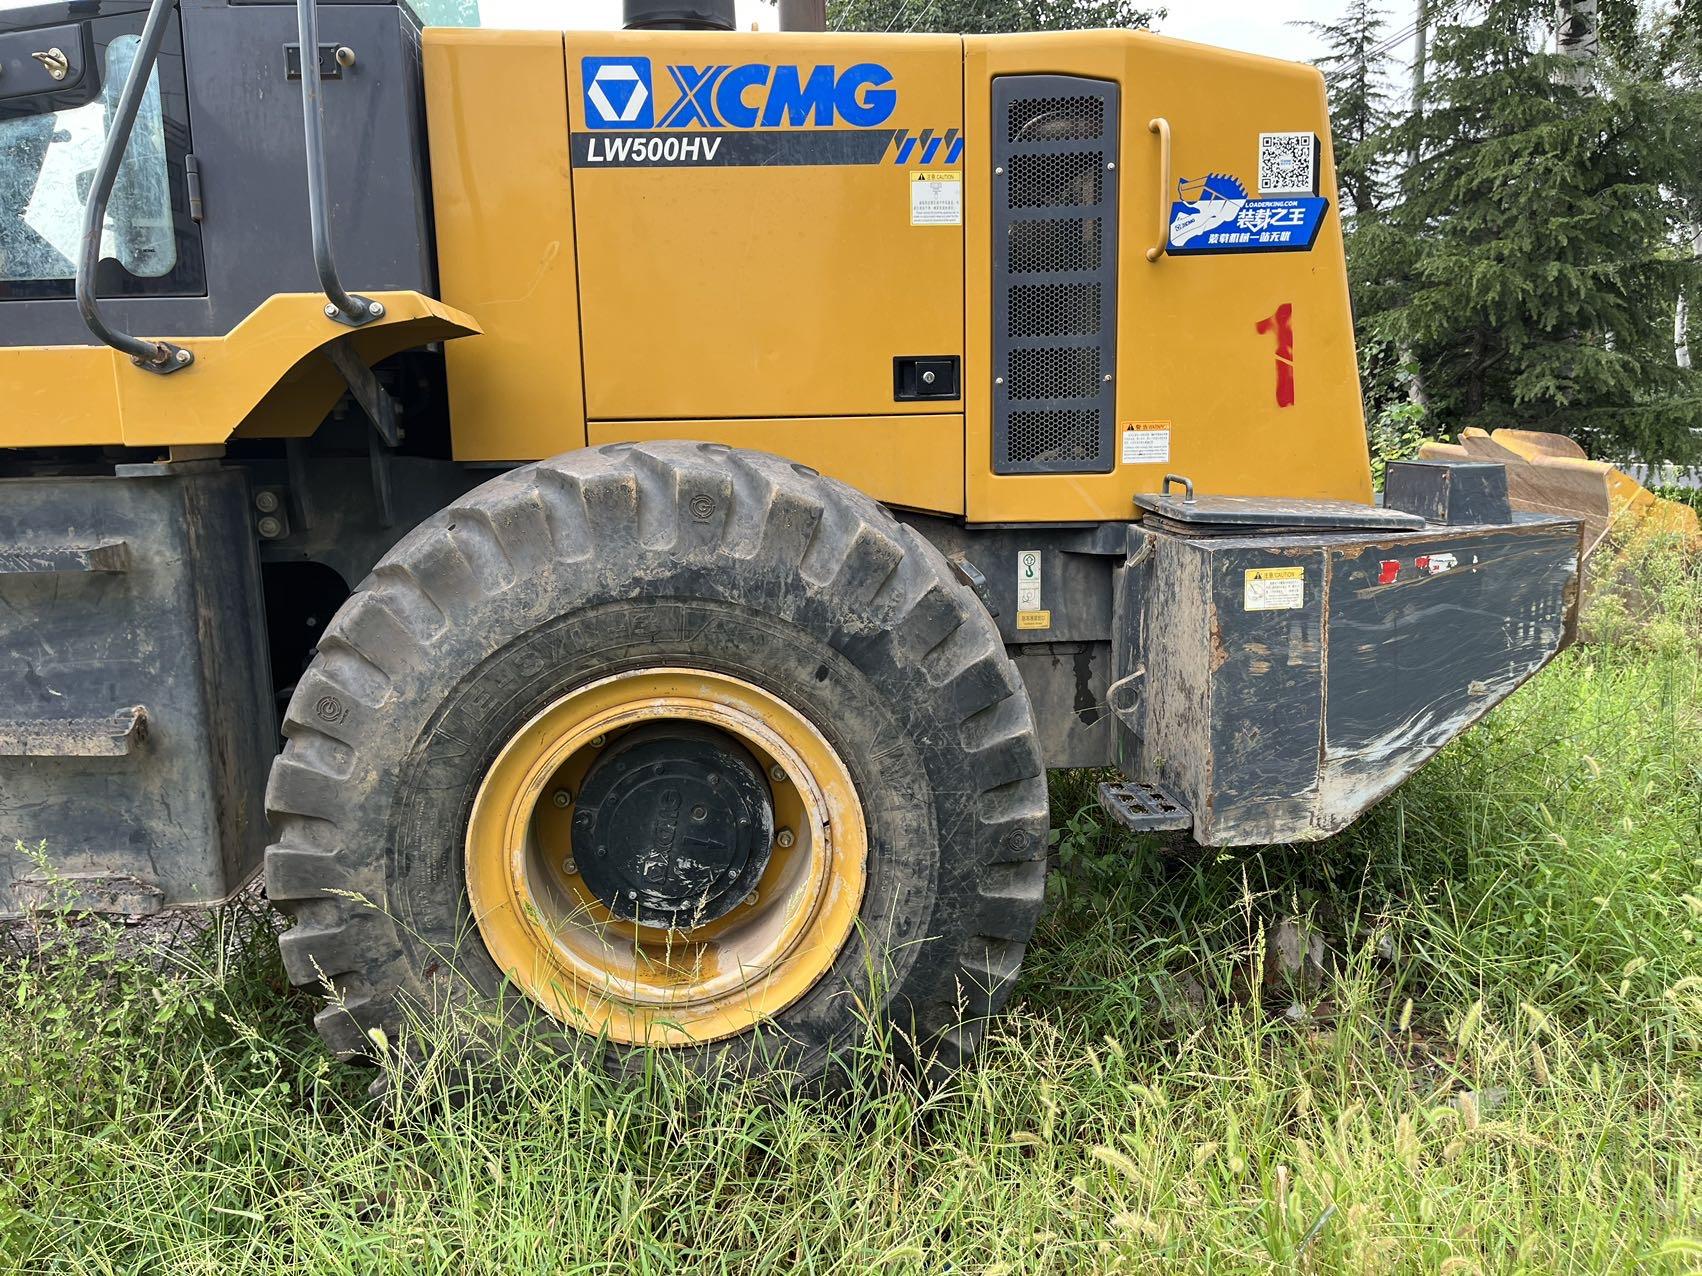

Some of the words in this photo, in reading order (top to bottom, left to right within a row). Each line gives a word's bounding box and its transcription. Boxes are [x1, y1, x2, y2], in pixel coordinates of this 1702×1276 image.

[655, 63, 897, 128] XCMG
[587, 137, 722, 162] LW500HV
[1245, 200, 1298, 208] LOADERKING.COM
[1236, 208, 1306, 232] 装载之王
[1255, 303, 1294, 408] 1
